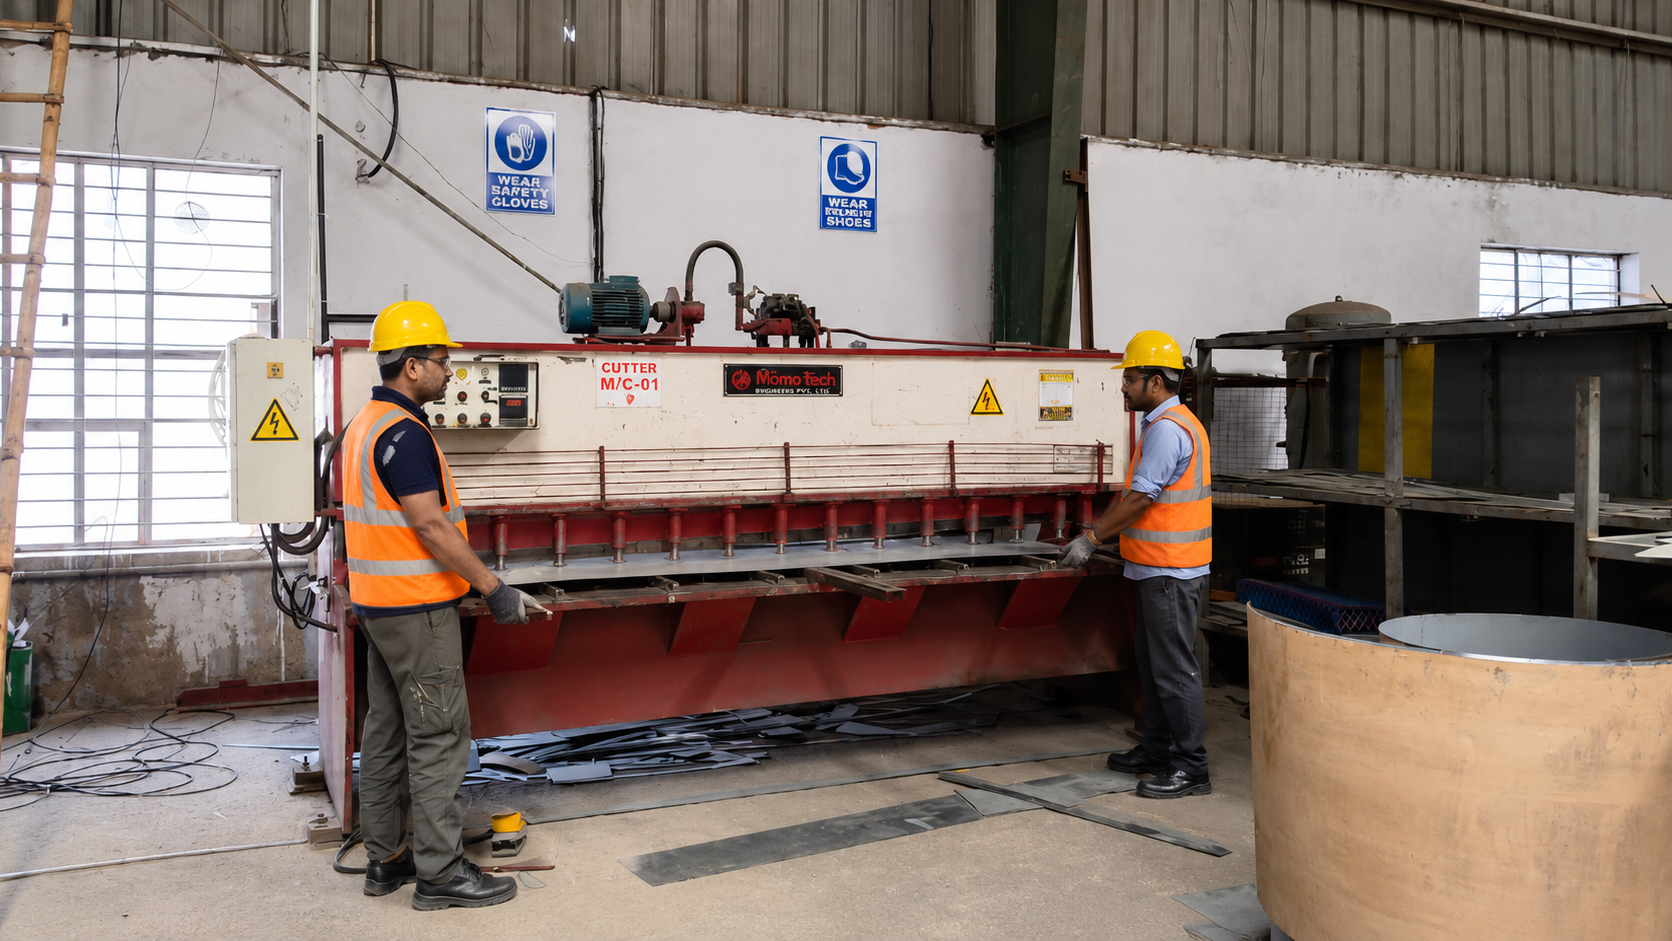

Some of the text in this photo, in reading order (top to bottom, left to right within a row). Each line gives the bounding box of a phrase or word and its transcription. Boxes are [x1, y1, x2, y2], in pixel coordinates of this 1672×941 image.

[497, 175, 541, 188] WEAR
[491, 196, 549, 210] GLOVES
[828, 197, 868, 210] WEAR
[826, 216, 872, 228] SHOES
[601, 362, 657, 374] CUTTER
[600, 376, 658, 391] M/C-01
